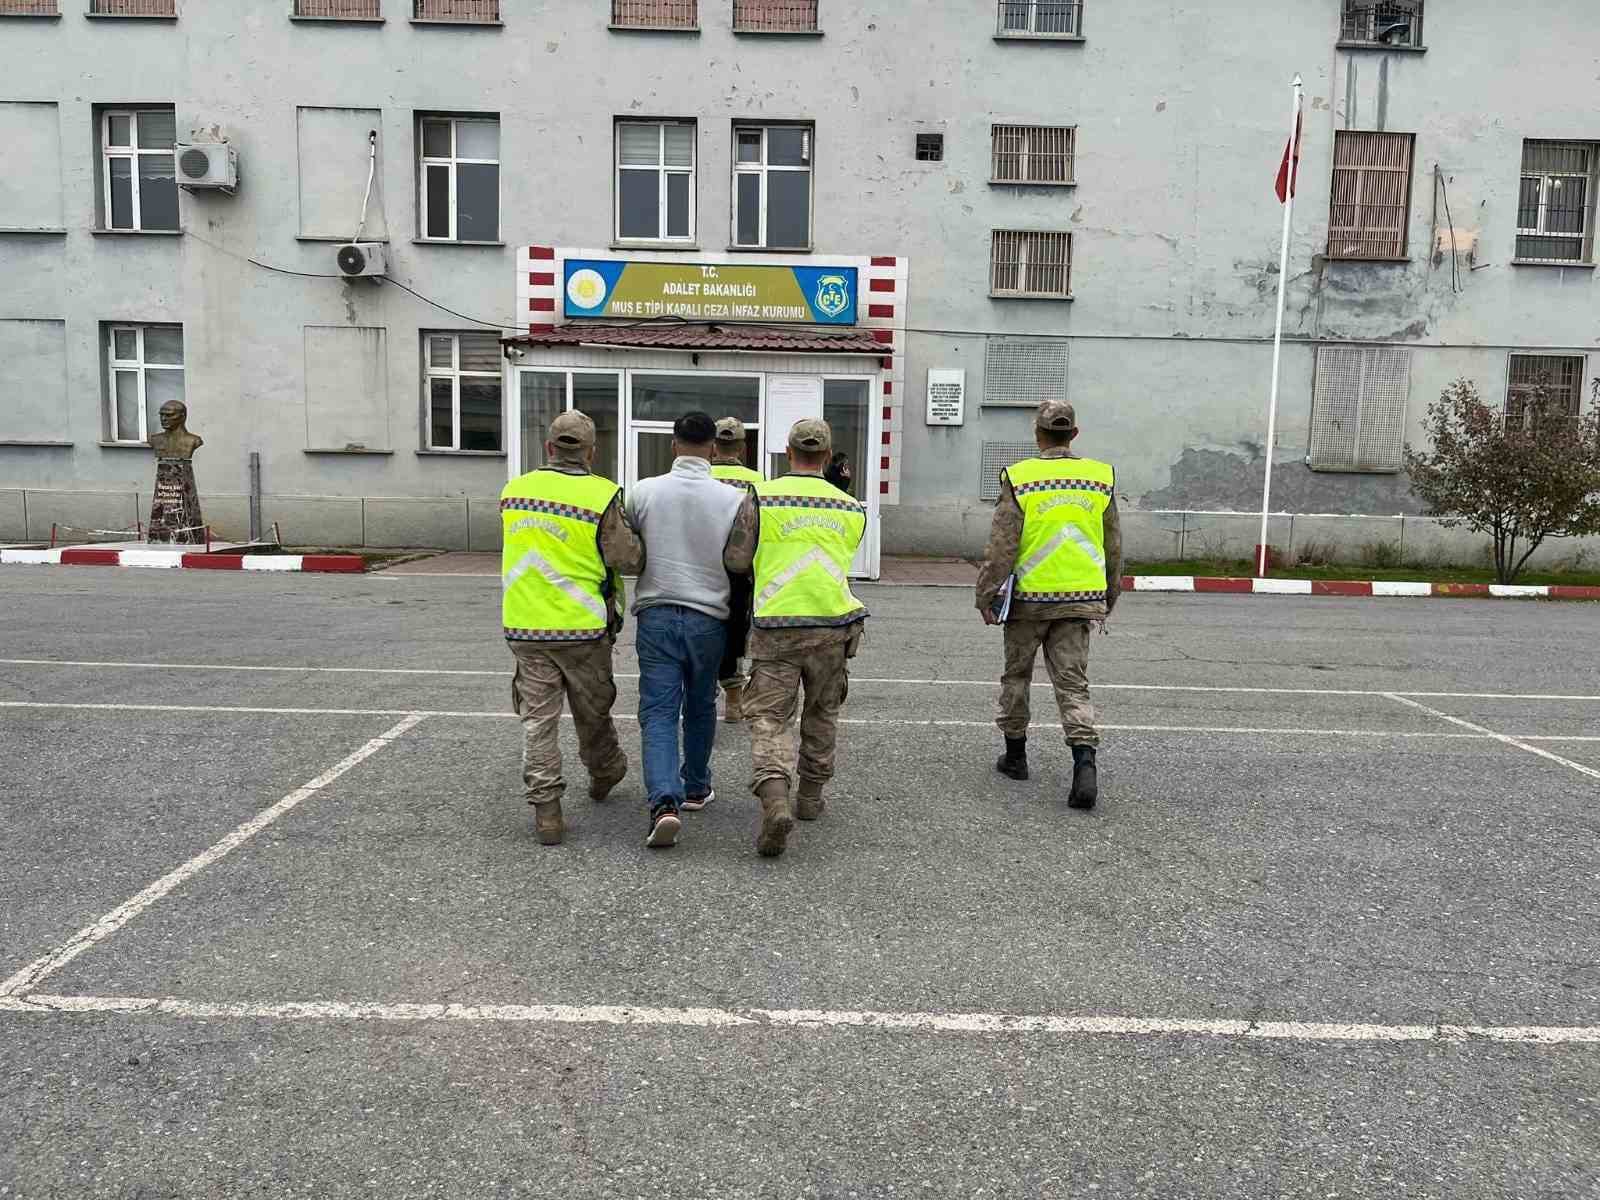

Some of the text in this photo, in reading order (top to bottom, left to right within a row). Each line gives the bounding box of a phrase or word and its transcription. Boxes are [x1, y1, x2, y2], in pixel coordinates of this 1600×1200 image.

[701, 266, 719, 278] T.C.
[663, 282, 756, 297] ADALET BAKANLIĞI
[636, 302, 643, 313] E
[644, 300, 664, 314] TİPİ
[667, 302, 701, 316] KAPALI
[704, 303, 729, 316] CEZA
[732, 302, 760, 317] İNFAZ
[762, 305, 805, 319] KURUMU
